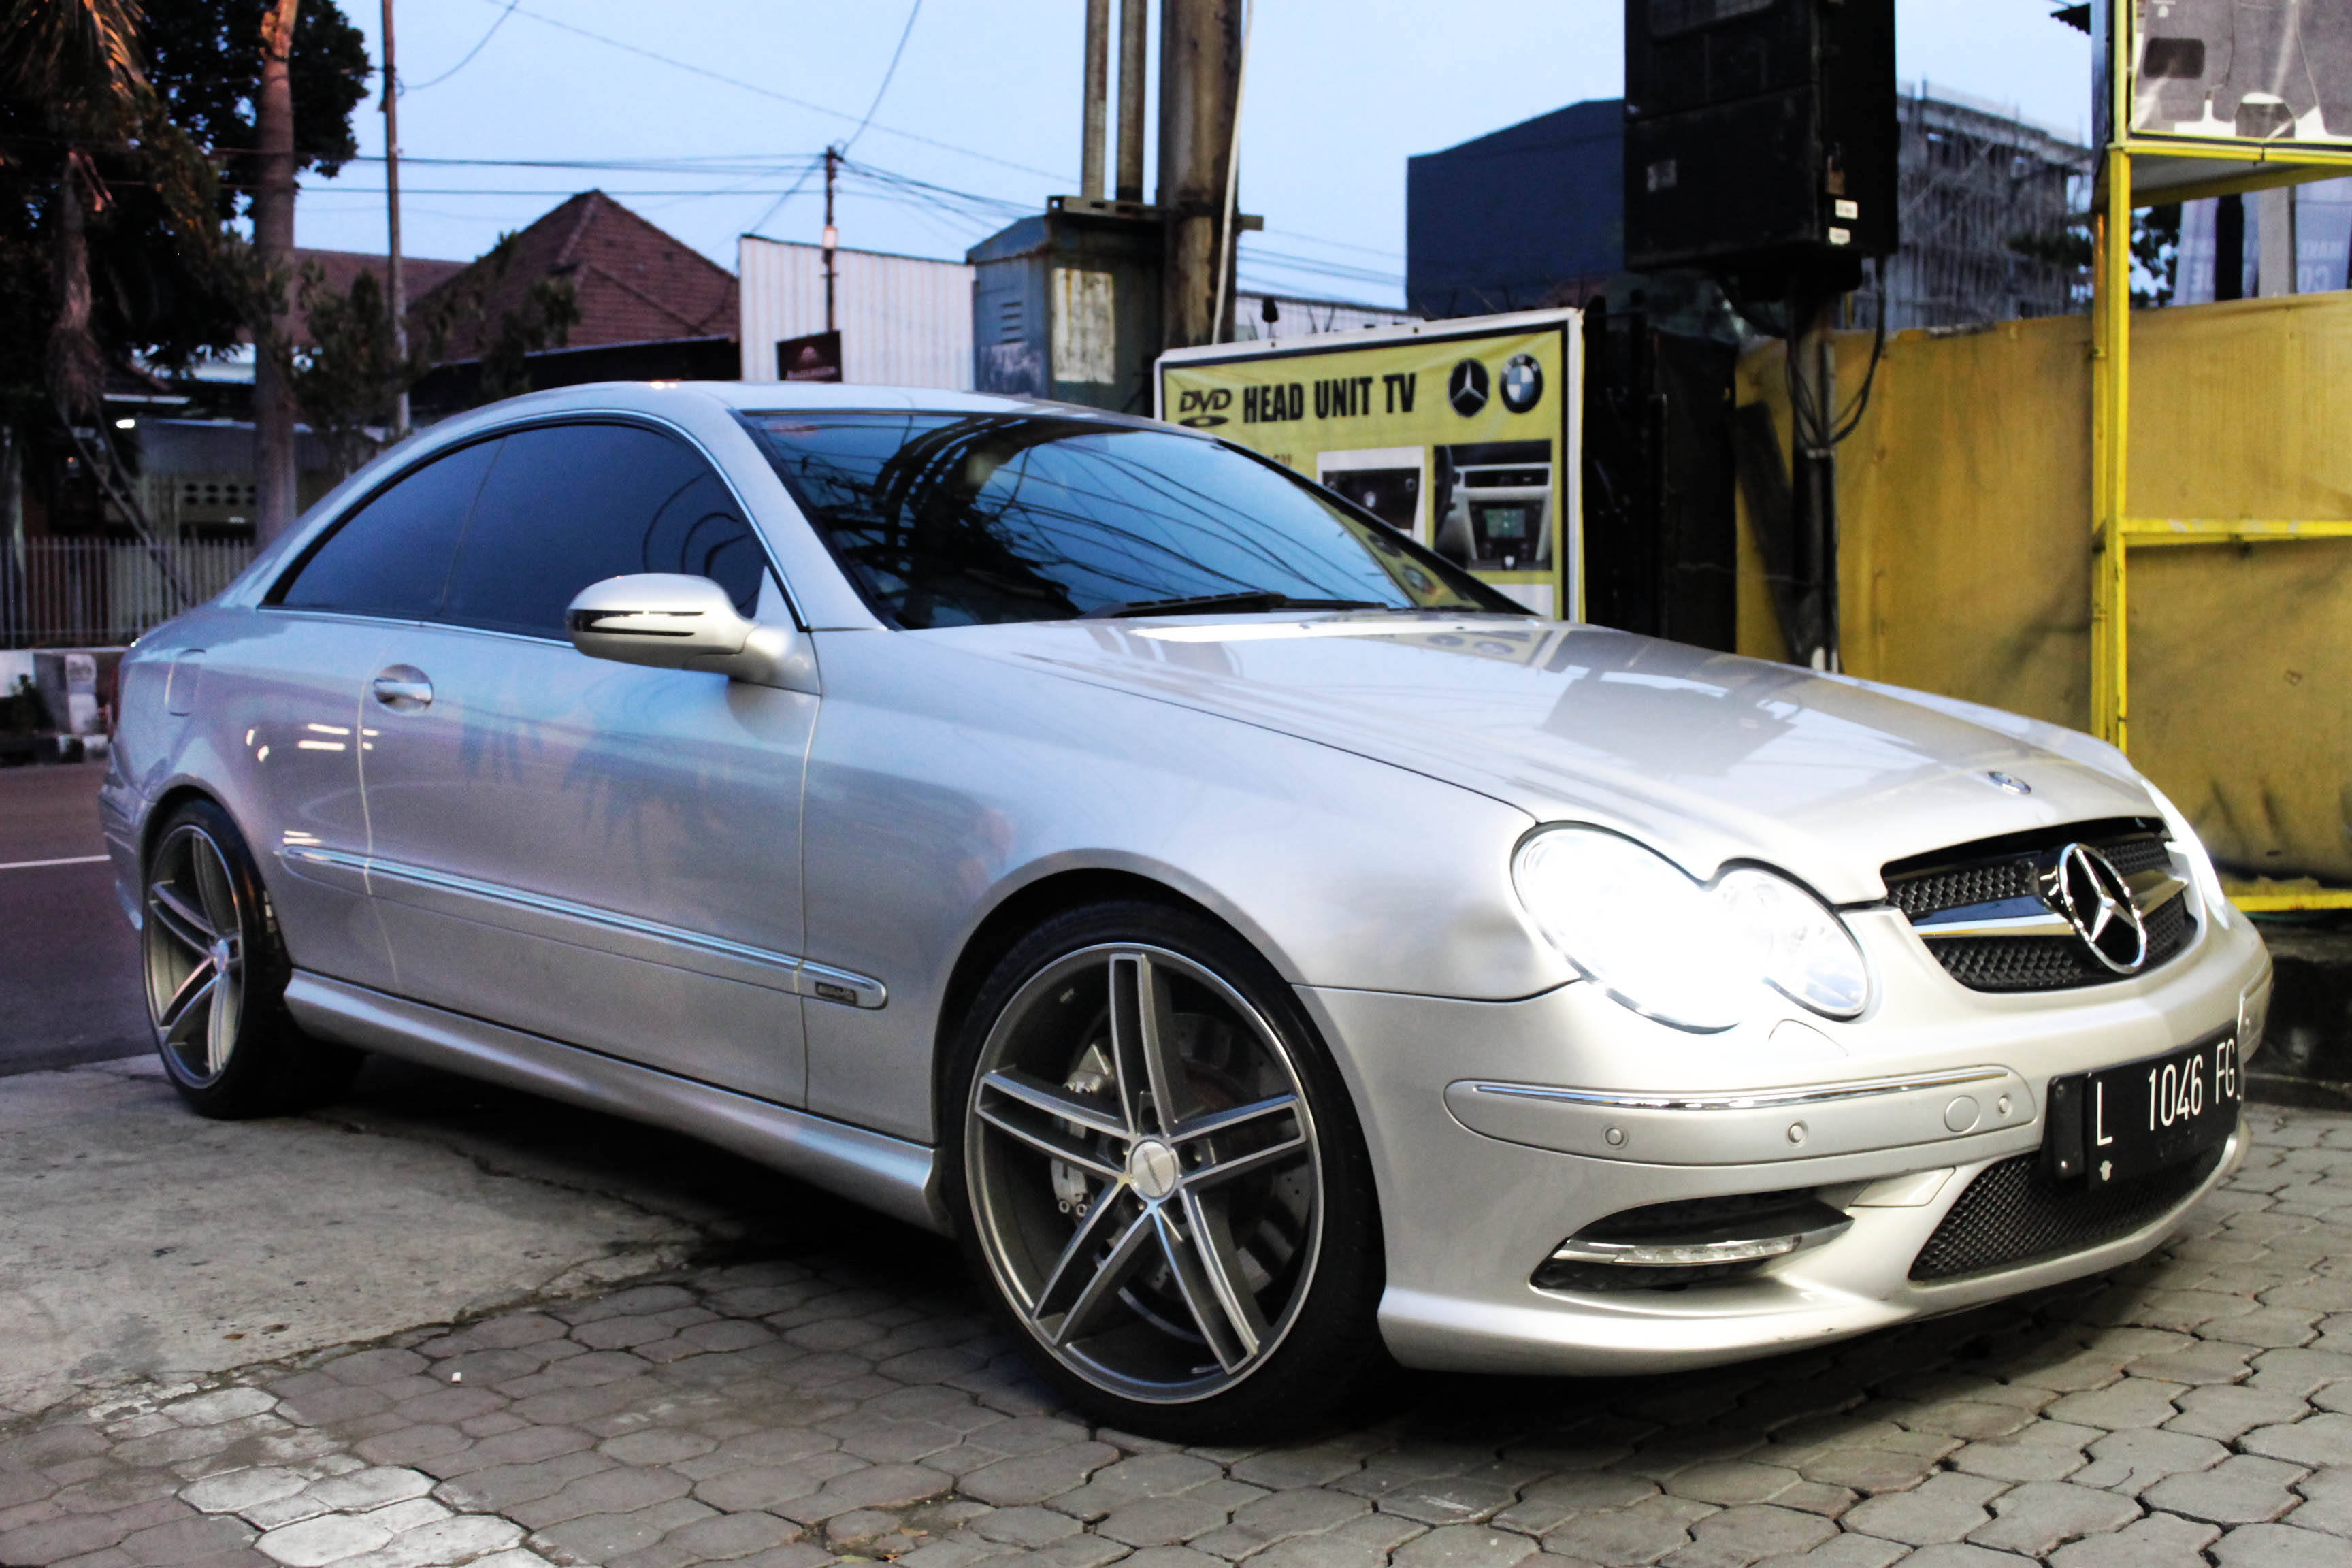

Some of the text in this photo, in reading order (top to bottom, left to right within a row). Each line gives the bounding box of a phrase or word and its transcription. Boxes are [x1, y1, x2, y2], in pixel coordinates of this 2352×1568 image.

[1179, 372, 1416, 423] DVD HEAD UNIT TV
[2097, 1038, 2235, 1147] L 1046 FG
